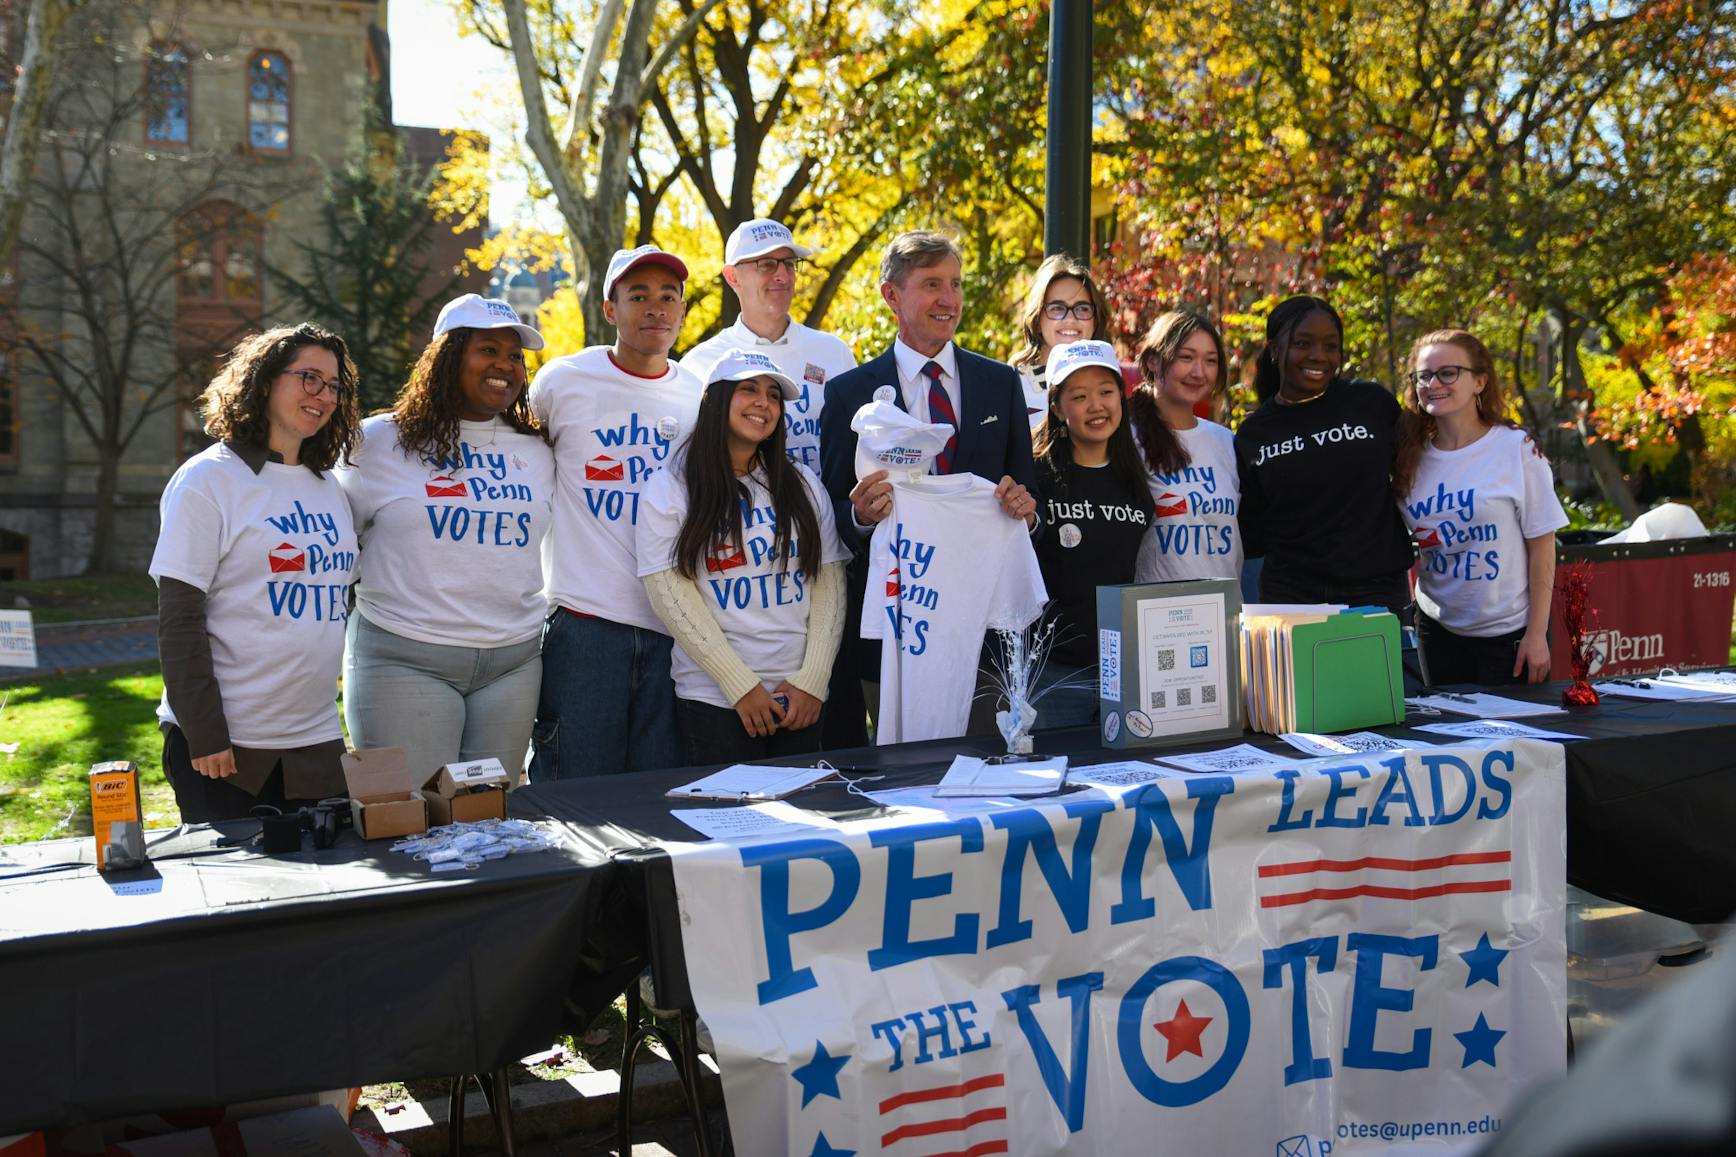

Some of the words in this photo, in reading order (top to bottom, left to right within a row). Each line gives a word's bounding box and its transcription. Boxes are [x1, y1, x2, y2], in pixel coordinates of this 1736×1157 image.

[1256, 436, 1304, 466] just
[1312, 422, 1375, 448] vote.
[468, 477, 532, 502] Penn
[1188, 491, 1235, 517] Penn
[1407, 482, 1474, 523] why
[265, 500, 339, 547] why
[425, 505, 531, 548] VOTES
[1047, 499, 1094, 525] just
[1153, 523, 1233, 555] VOTES
[1438, 520, 1498, 547] Penn
[306, 544, 353, 575] Penn
[708, 569, 805, 610] VOTES
[1693, 571, 1730, 588] 21-1316
[266, 580, 350, 623] VOTES
[1608, 630, 1664, 665] Penn
[1102, 657, 1110, 696] PENN
[739, 775, 1235, 1006] PENN
[1266, 750, 1515, 833] LEADS
[871, 1000, 992, 1073] THE
[1001, 931, 1440, 1134] VOTE
